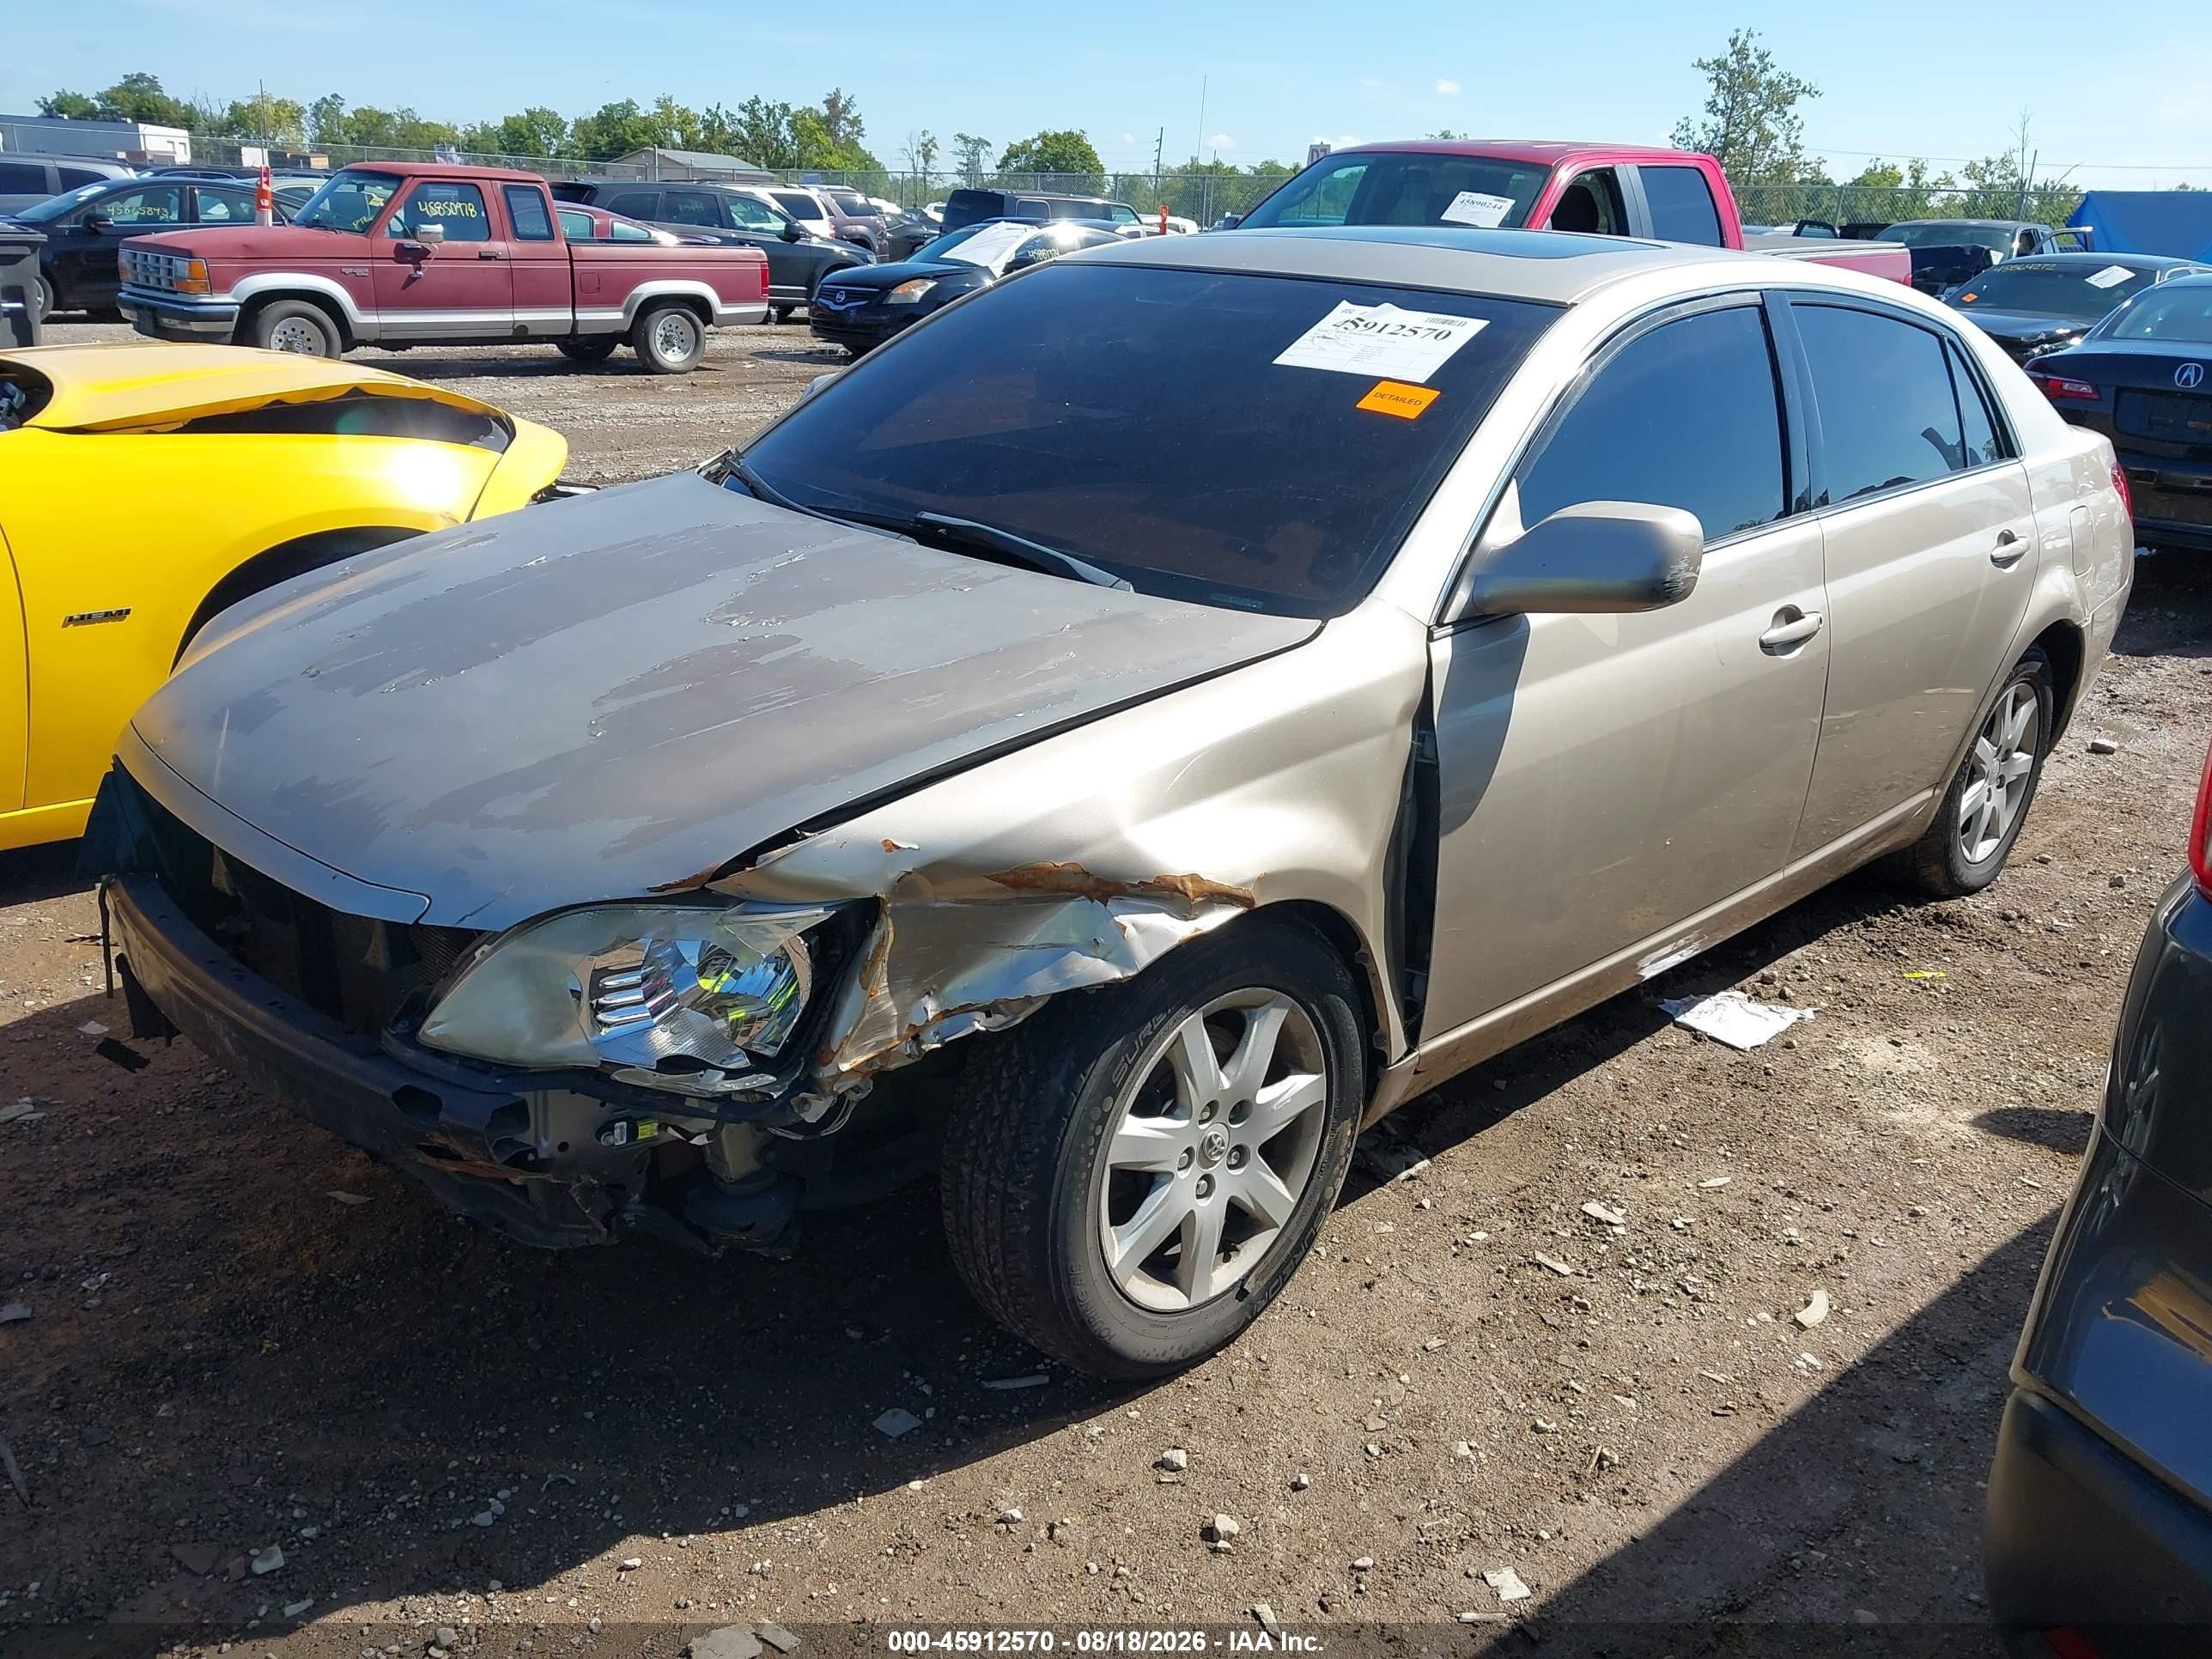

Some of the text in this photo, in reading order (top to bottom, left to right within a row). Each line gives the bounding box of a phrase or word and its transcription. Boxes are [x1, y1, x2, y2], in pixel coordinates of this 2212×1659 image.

[107, 205, 169, 217] 45865843
[417, 201, 477, 218] 45850978
[1373, 392, 1423, 406] DETAILED
[67, 608, 131, 623] HEMI
